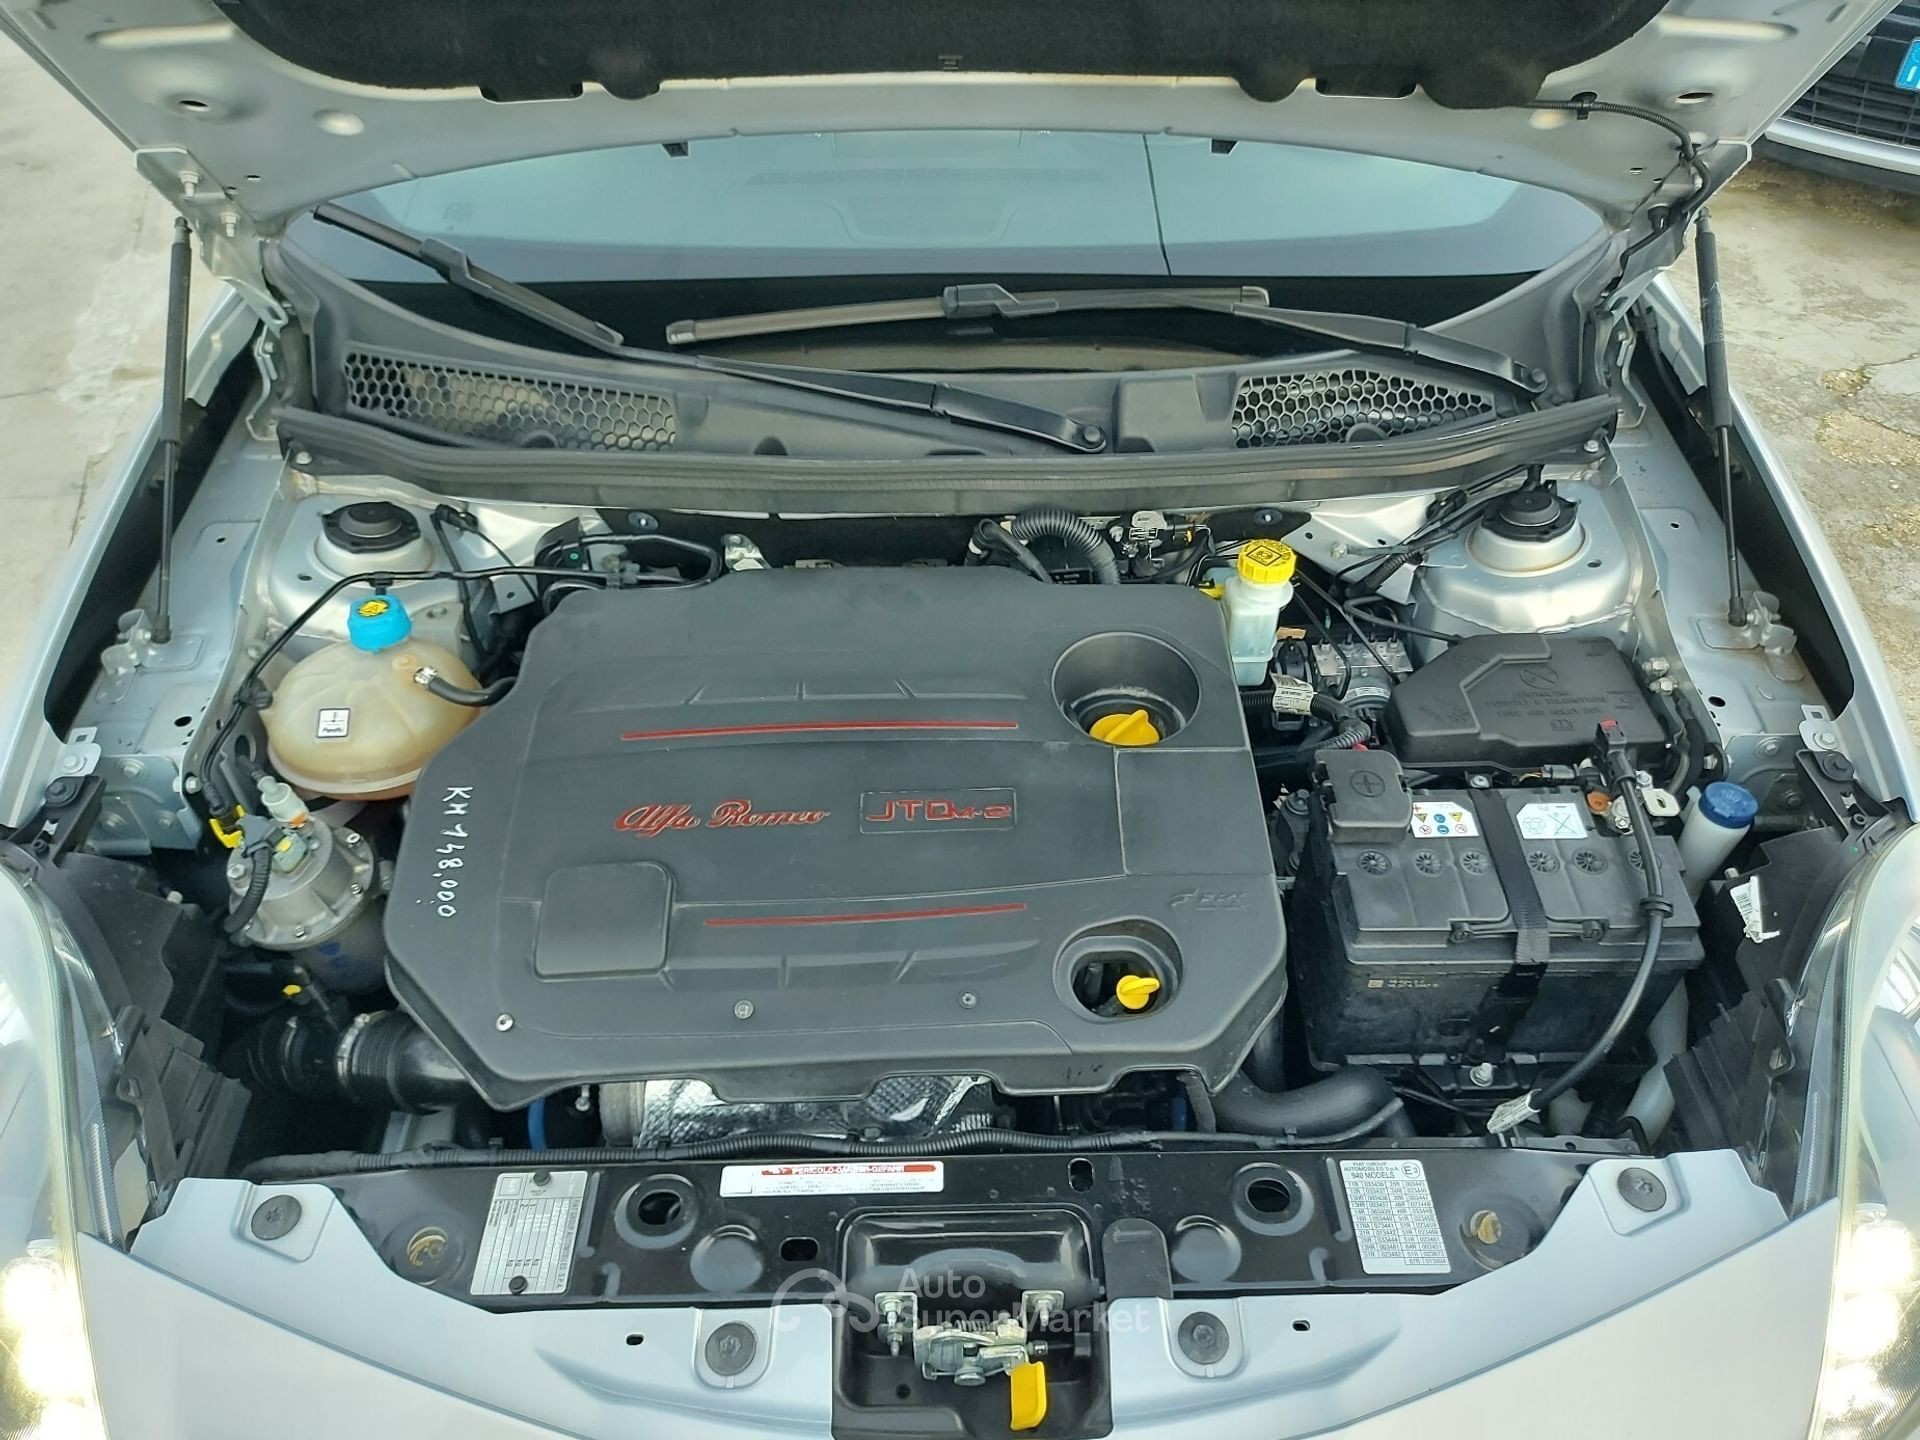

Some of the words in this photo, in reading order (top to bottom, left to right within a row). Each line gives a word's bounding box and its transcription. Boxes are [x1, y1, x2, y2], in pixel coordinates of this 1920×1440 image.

[613, 801, 702, 838] Alfa
[706, 799, 830, 832] Romeo
[1365, 1171, 1396, 1179] MODELS
